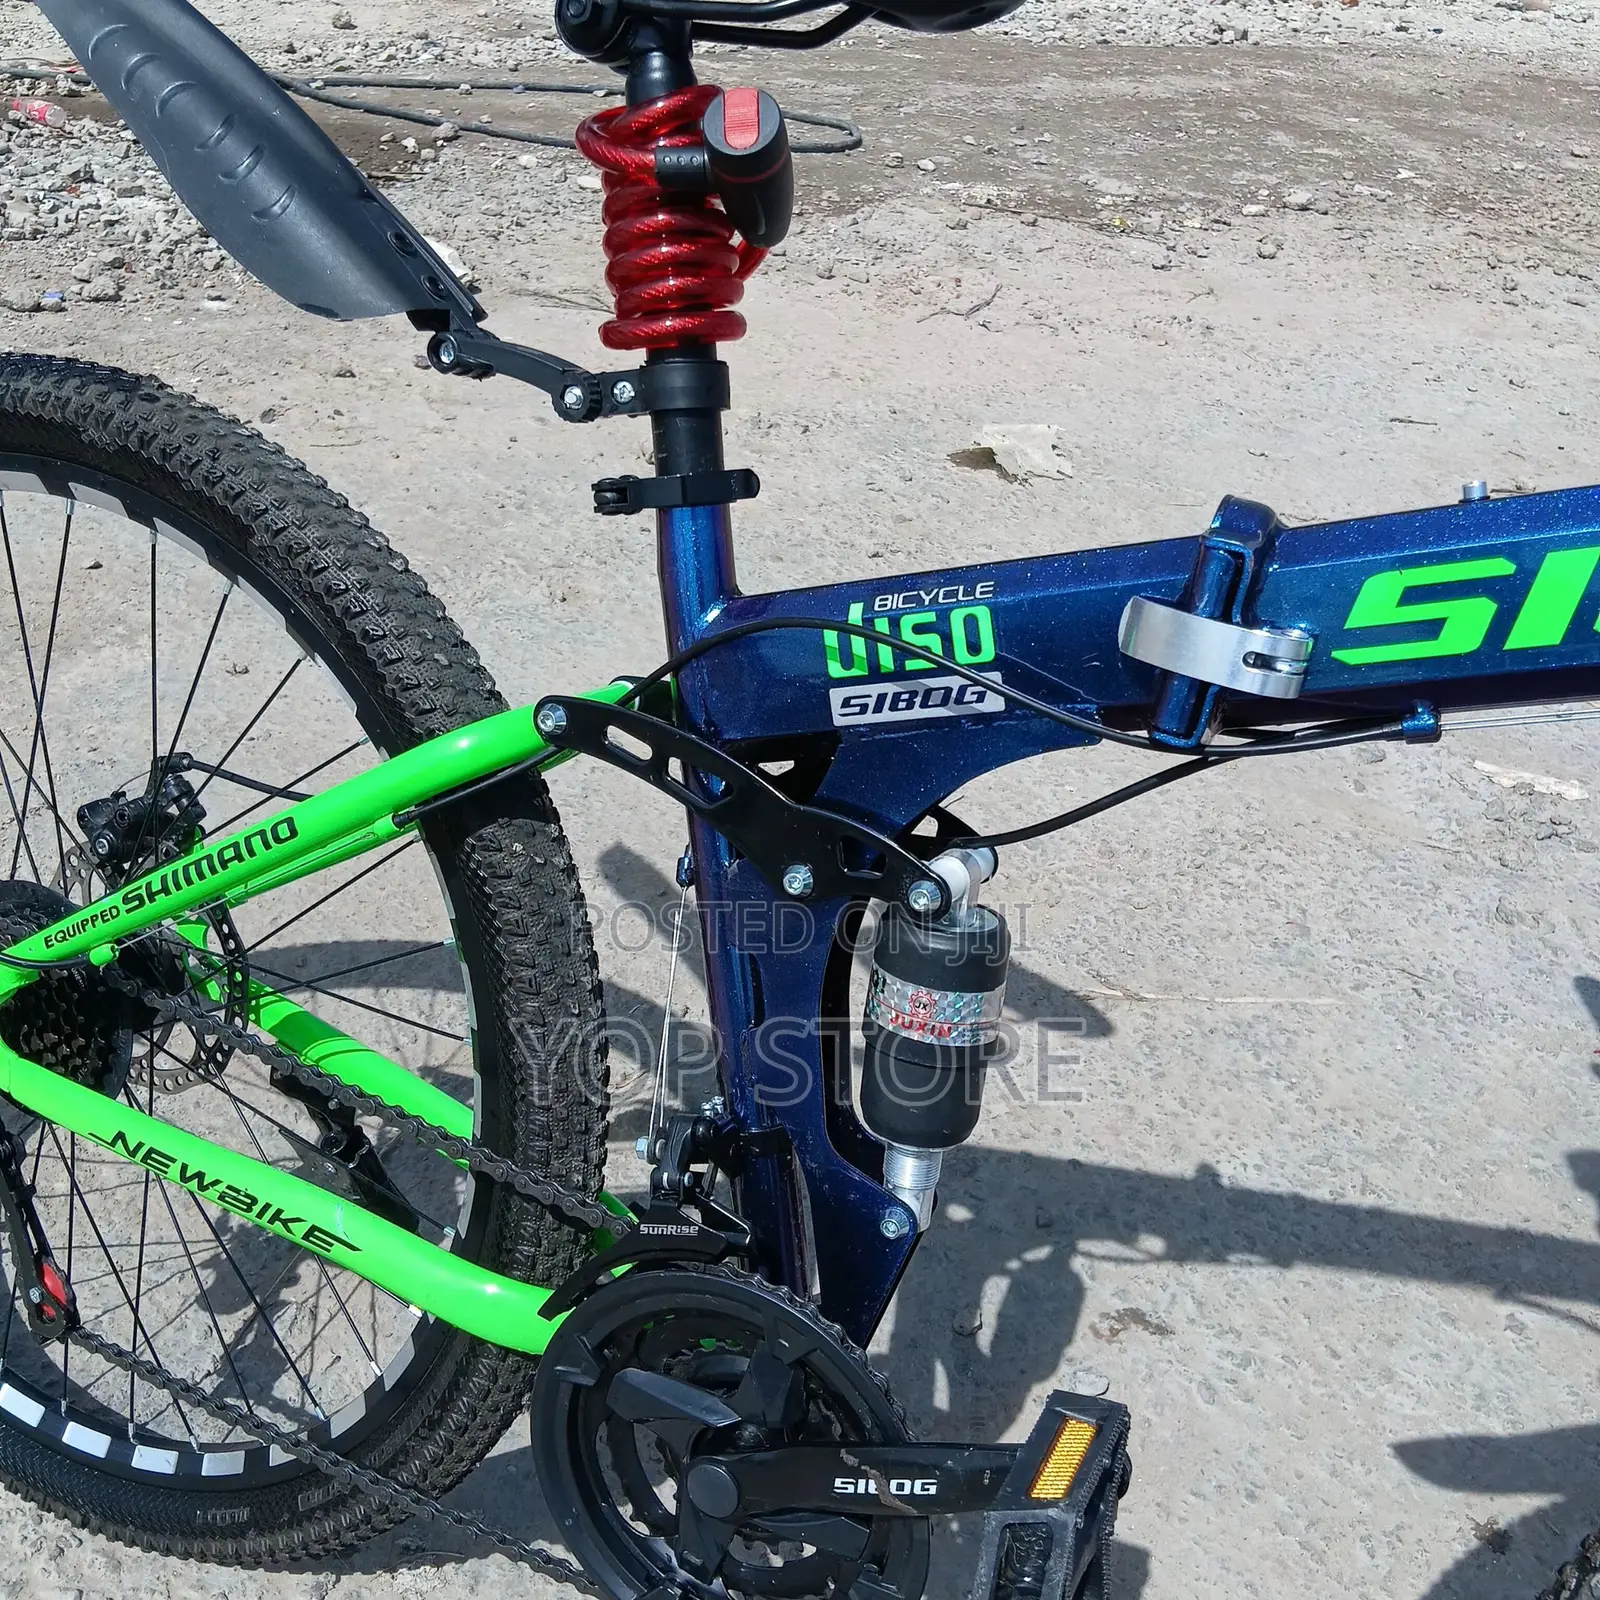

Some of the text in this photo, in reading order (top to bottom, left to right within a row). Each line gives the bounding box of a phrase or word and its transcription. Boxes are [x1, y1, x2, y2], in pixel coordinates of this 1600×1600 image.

[873, 581, 995, 612] BICYCLE
[1331, 546, 1600, 666] SI
[838, 684, 988, 717] SIBOG
[43, 816, 299, 950] EQUIPPED SHIMANO
[915, 1002, 928, 1011] JX
[889, 1012, 952, 1038] JUXIN
[88, 1131, 363, 1253] NEWBIKE
